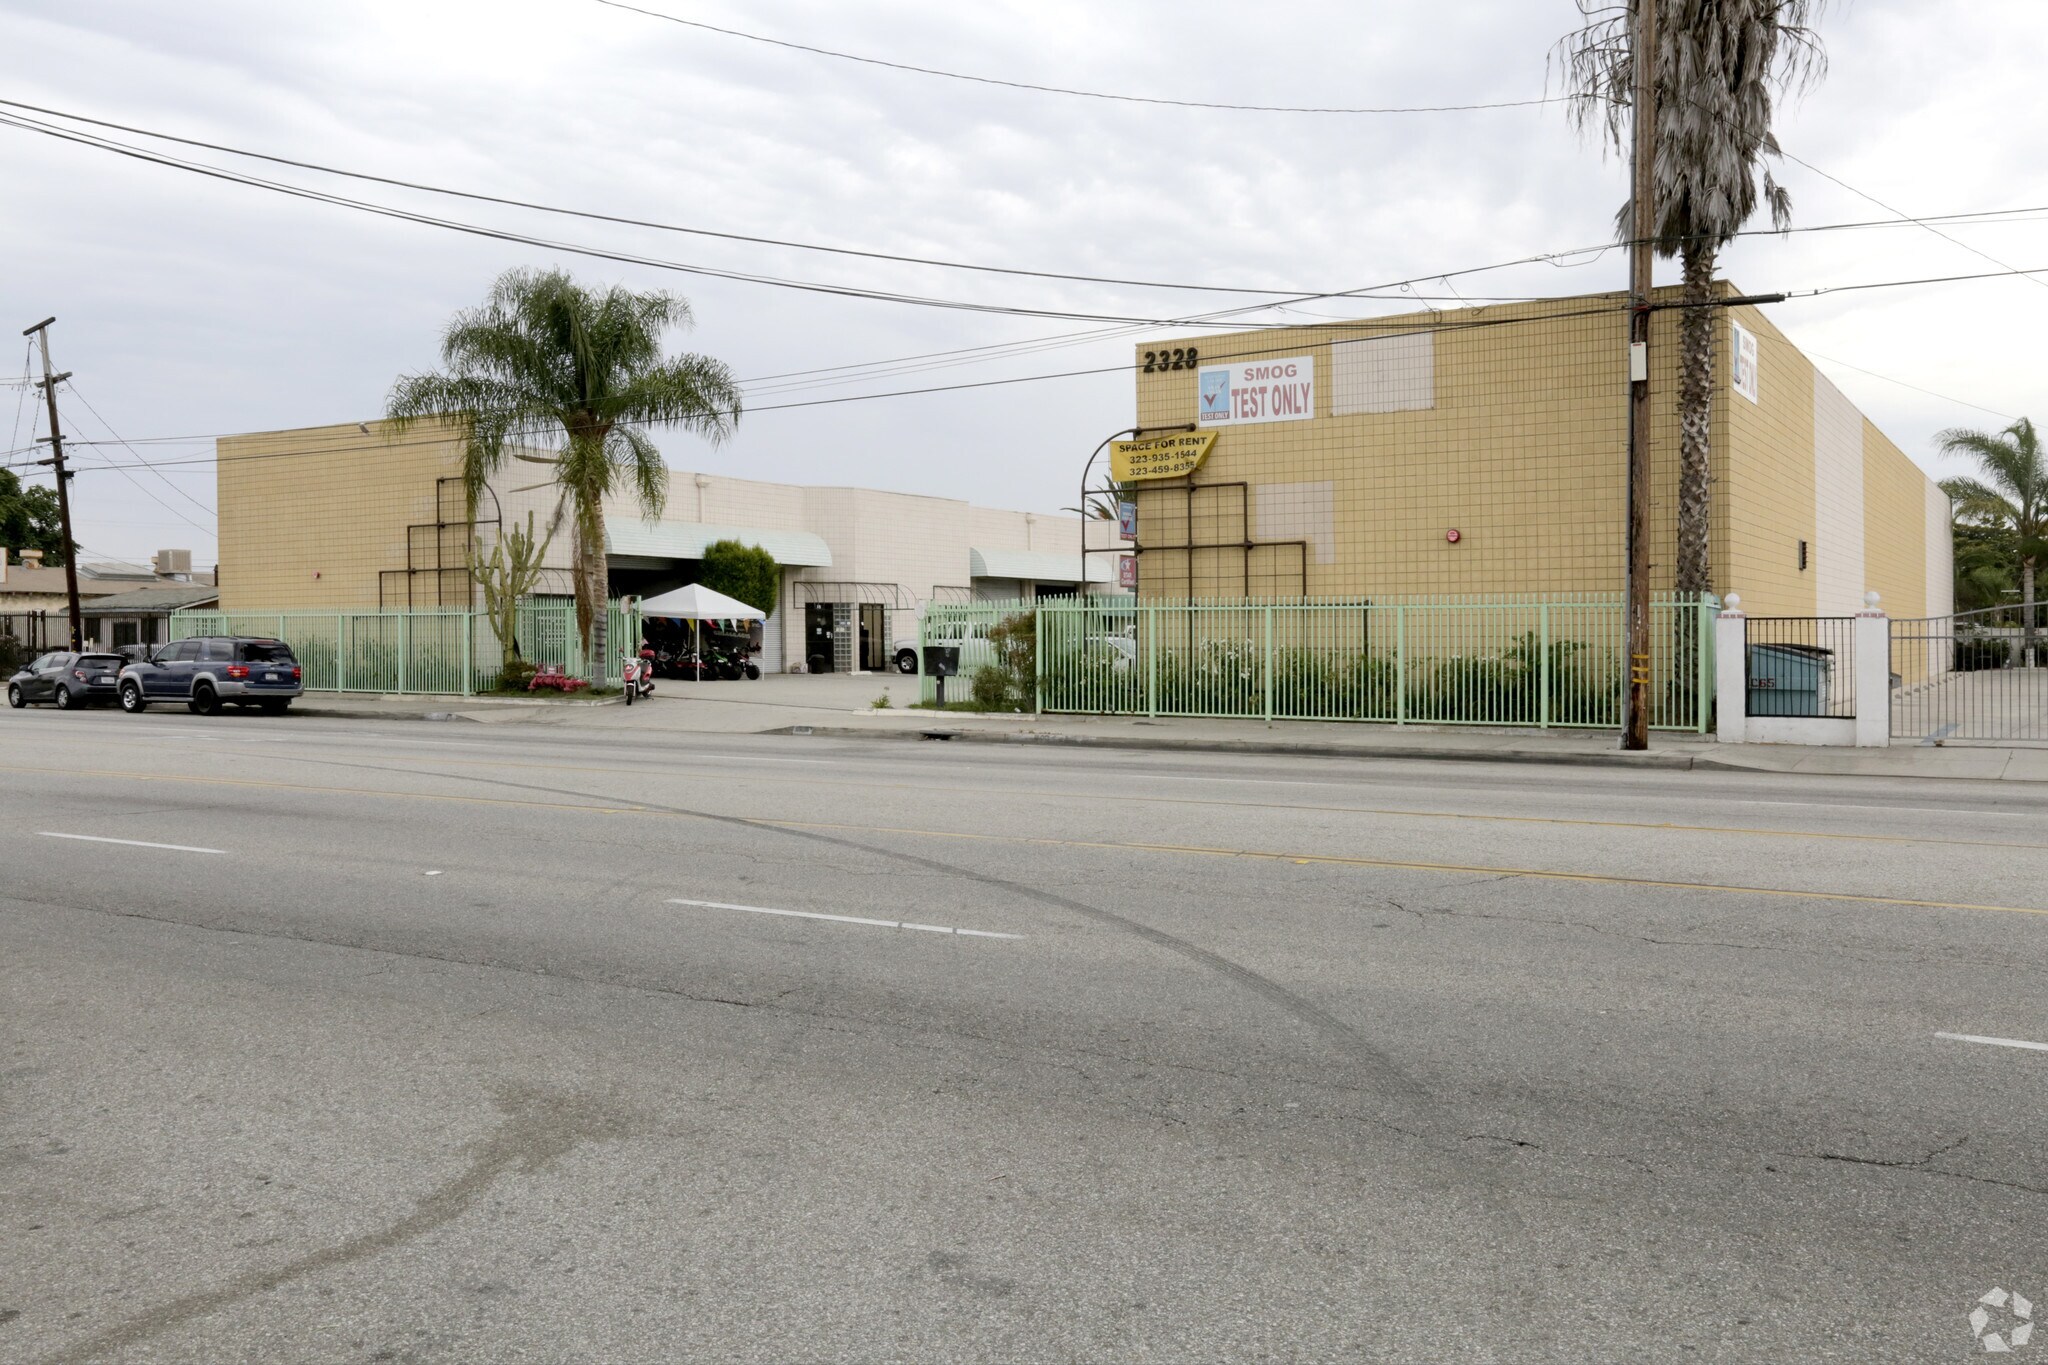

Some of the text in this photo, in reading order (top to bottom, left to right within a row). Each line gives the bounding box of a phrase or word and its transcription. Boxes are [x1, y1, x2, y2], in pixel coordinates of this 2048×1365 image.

[1143, 347, 1198, 373] 2328
[1244, 364, 1297, 381] SMOG
[1231, 382, 1310, 419] TEST ONLY
[1202, 411, 1229, 420] TEST ONLY
[1119, 437, 1207, 453] SPACE FOR RENT
[1129, 449, 1197, 464] 323-935-1544
[1129, 461, 1195, 476] 323-459-8355
